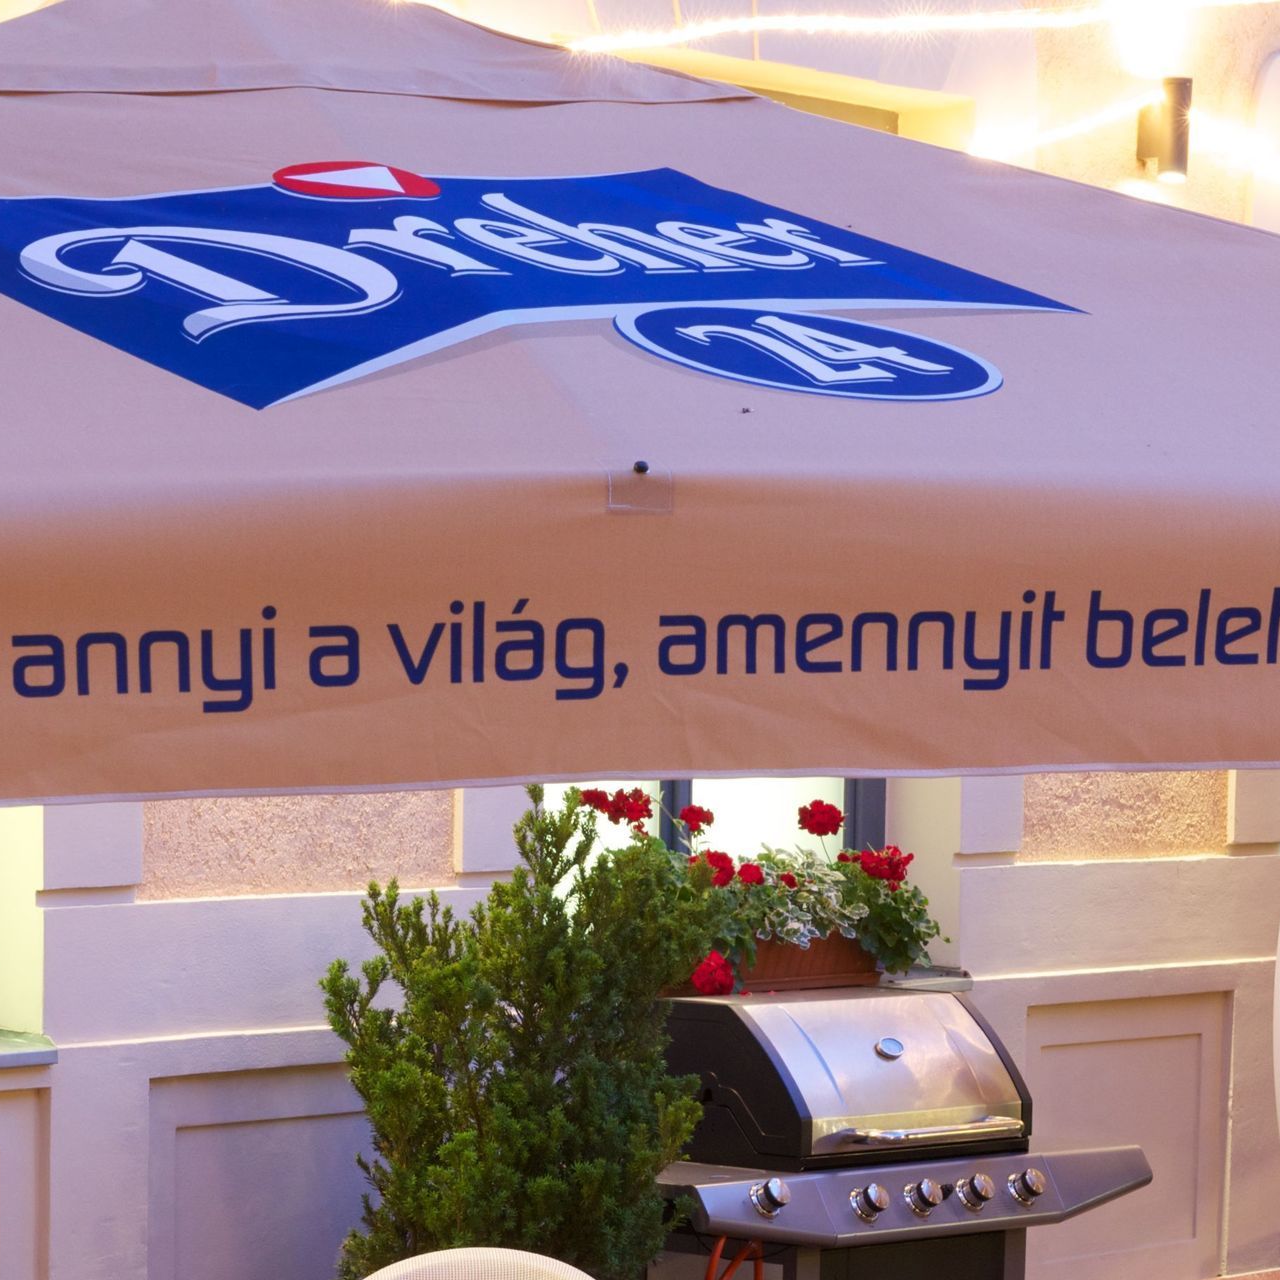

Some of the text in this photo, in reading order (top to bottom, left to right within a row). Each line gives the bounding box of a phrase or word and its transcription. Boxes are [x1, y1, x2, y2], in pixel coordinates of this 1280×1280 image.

[20, 192, 883, 344] Dreher
[675, 315, 952, 387] 24
[11, 605, 277, 713] annyi
[308, 624, 360, 688] a
[386, 598, 630, 700] világ,
[657, 589, 1065, 691] amennyit
